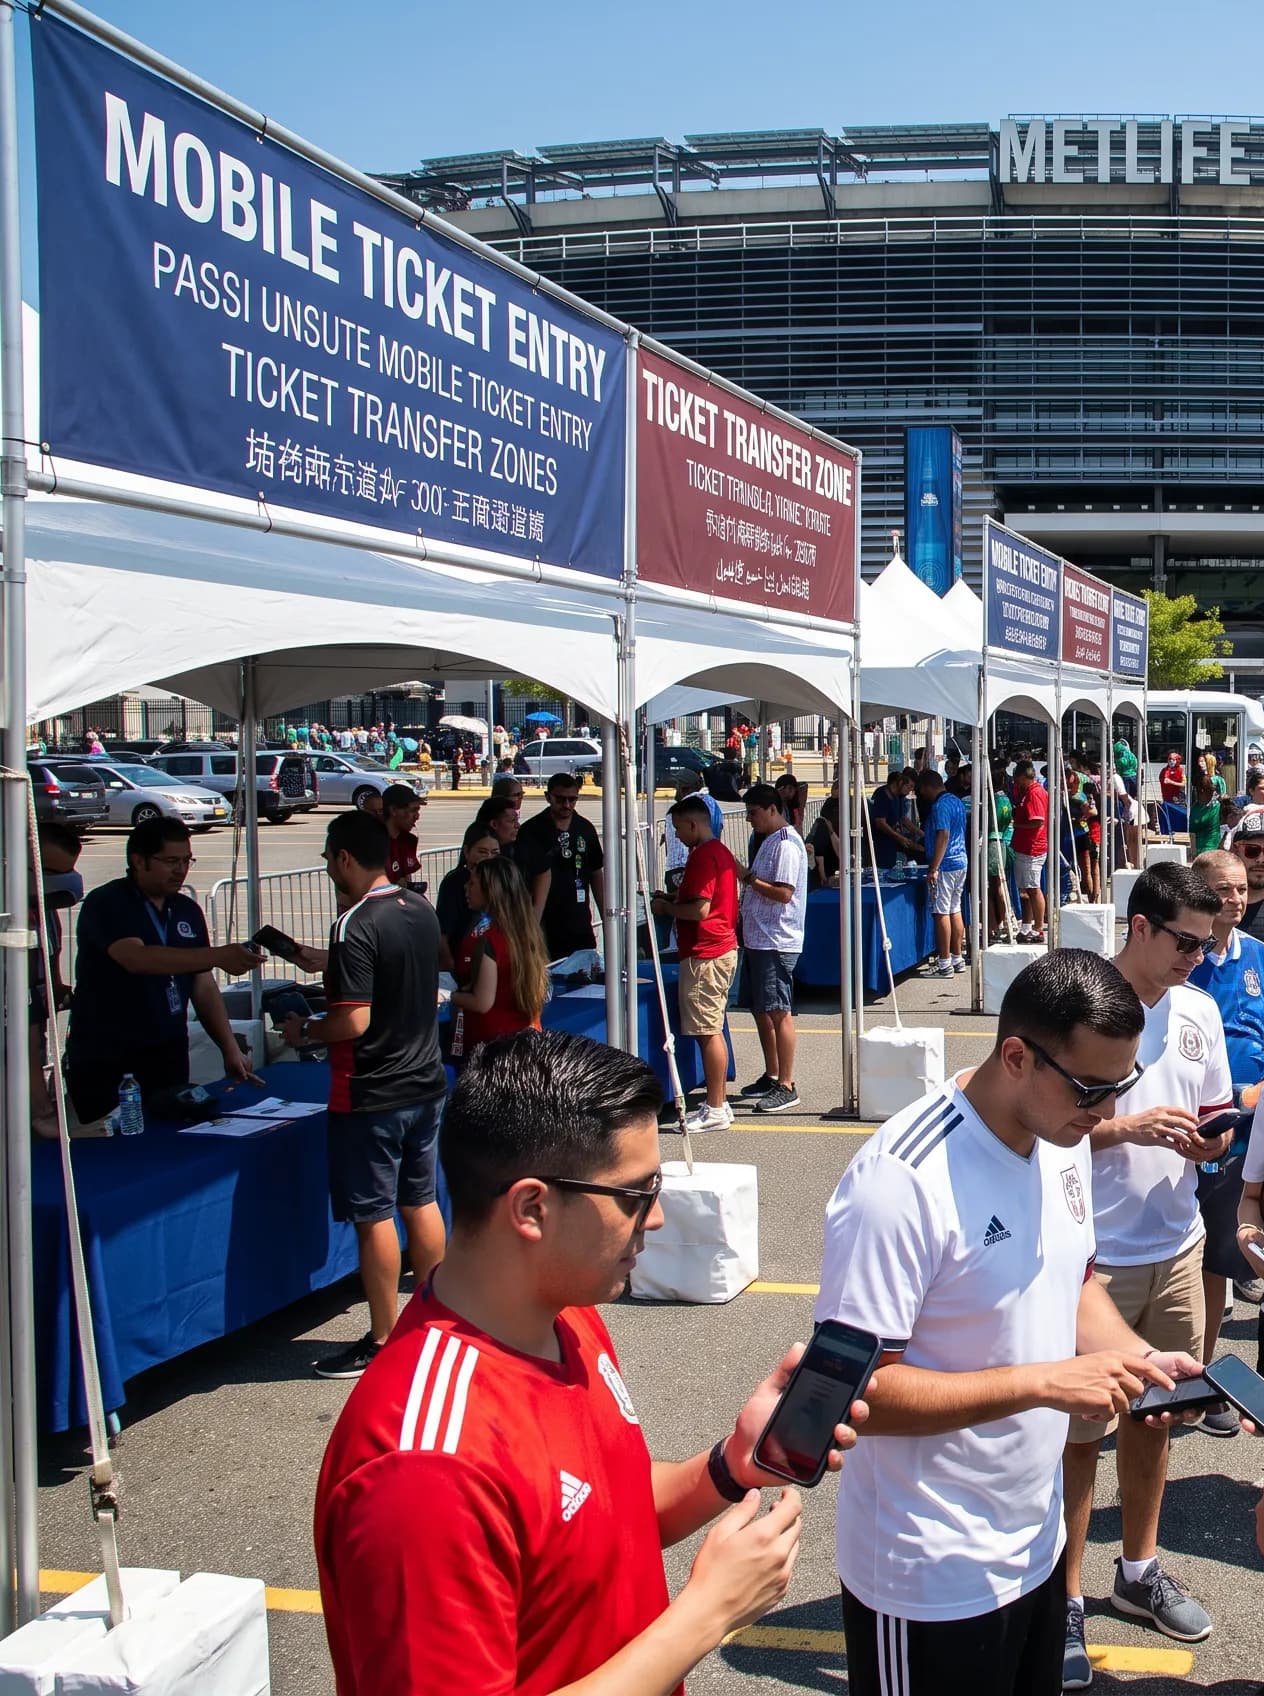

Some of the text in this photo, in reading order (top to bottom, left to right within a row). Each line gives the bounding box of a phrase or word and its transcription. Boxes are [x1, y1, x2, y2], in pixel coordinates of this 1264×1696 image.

[999, 119, 1251, 185] METLIFE
[104, 91, 606, 402] MOBILE TICKET ENTRY
[152, 241, 594, 453] PASSI UNSUTE MOBILE TICKET ENTRY
[221, 342, 340, 424] TICKET
[347, 388, 483, 473] TRANSFER
[490, 436, 558, 497] ZONES
[642, 368, 719, 448] TICKET
[723, 408, 812, 491] TRANSFER
[815, 454, 852, 507] ZONE
[686, 459, 725, 497] TICKET
